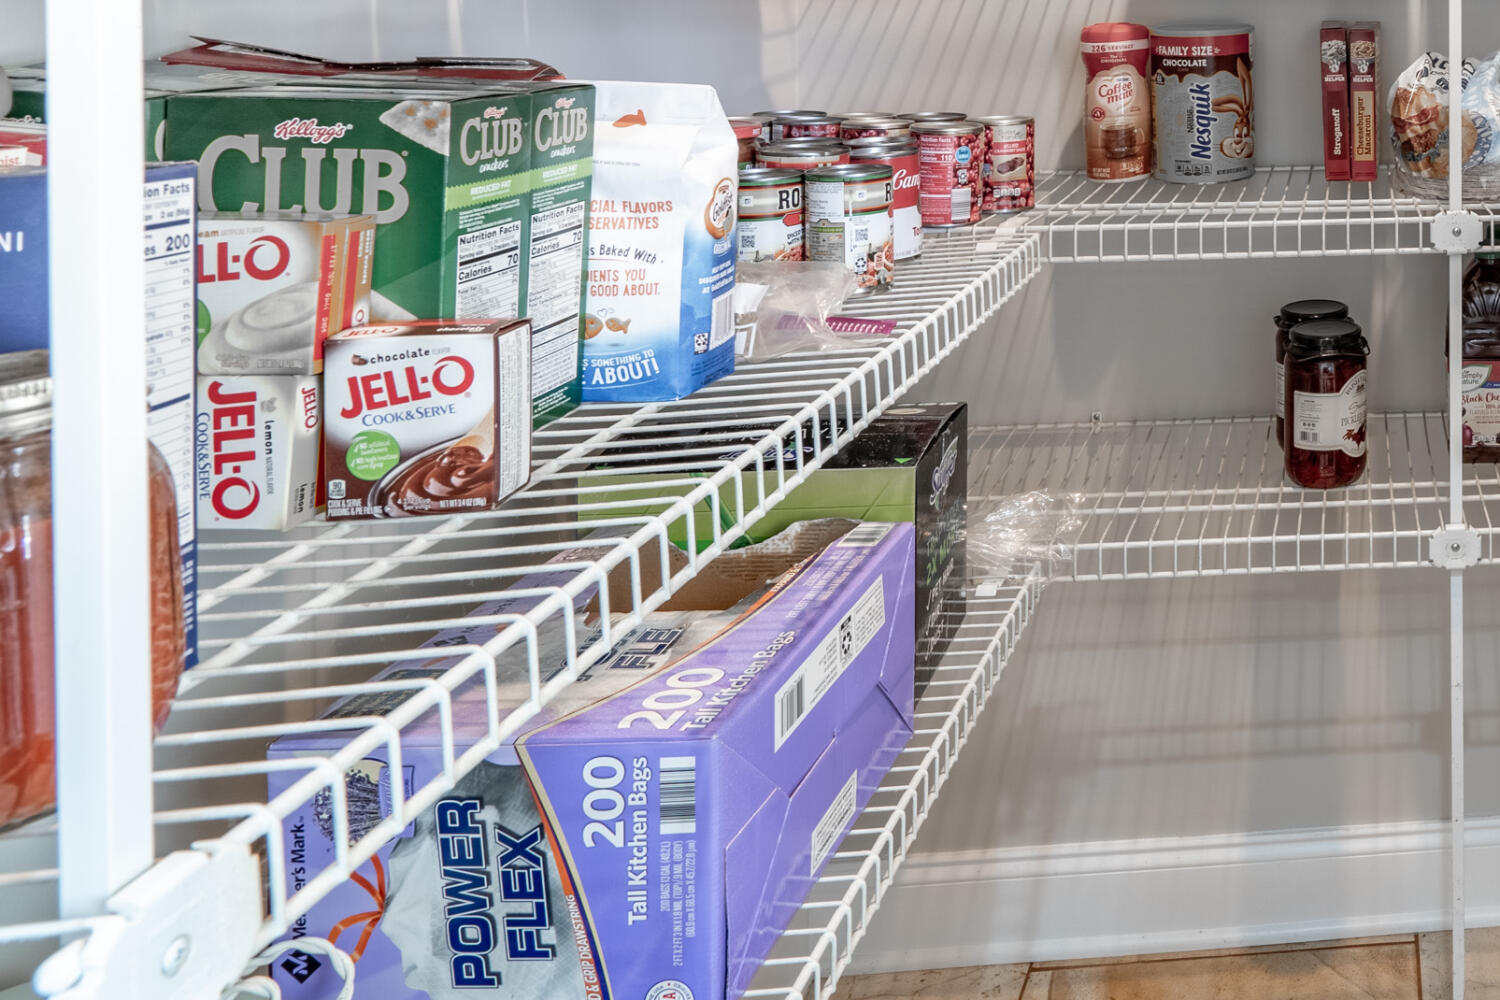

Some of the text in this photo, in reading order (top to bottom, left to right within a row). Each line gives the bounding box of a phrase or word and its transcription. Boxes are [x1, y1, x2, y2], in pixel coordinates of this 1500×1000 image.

[1158, 46, 1213, 56] FAMILY SIZE
[1162, 58, 1208, 67] CHOCOLATE
[1098, 81, 1132, 98] Coffee
[1107, 90, 1133, 104] mate
[274, 118, 346, 144] Kellogg's
[534, 106, 588, 152] CLUB
[1190, 83, 1217, 159] Nesquik
[1332, 108, 1342, 155] Stroganoff
[1357, 97, 1365, 155] Cheeseburger
[460, 117, 523, 166] CLUB
[198, 134, 409, 224] CLUB
[568, 164, 578, 174] FAT
[163, 181, 190, 196] Facts
[470, 180, 512, 196] REDUCED FAT
[532, 203, 584, 224] Nutrition Facts
[622, 200, 673, 214] FLAVORS
[166, 233, 190, 252] 200
[459, 223, 519, 246] Nutrition Facts
[572, 230, 582, 242] 70
[507, 252, 518, 264] 70
[531, 241, 560, 256] Calories
[599, 244, 657, 264] Baked With
[458, 266, 492, 281] Calories
[625, 269, 646, 281] YOU
[590, 282, 661, 297] GOOD ABOUT.
[370, 348, 430, 364] chocolate
[591, 349, 654, 367] SOMETHING TO
[592, 357, 660, 385] ABOUT!
[340, 355, 475, 419] JELL-O
[302, 387, 318, 429] JELL-O
[264, 420, 275, 455] lemon
[208, 381, 260, 520] JELL-O
[332, 481, 342, 490] 90
[299, 483, 308, 513] lemon
[680, 630, 795, 732] Tall Kitchen Bags
[617, 667, 725, 729] 200
[582, 756, 625, 848] 200
[627, 756, 651, 925] Tall Kitchen Bags
[291, 822, 305, 941] Meer's Mark
[494, 825, 553, 961] FLEX
[435, 799, 499, 989] POWER
[566, 894, 595, 983] GRIP DRAWSTRING
